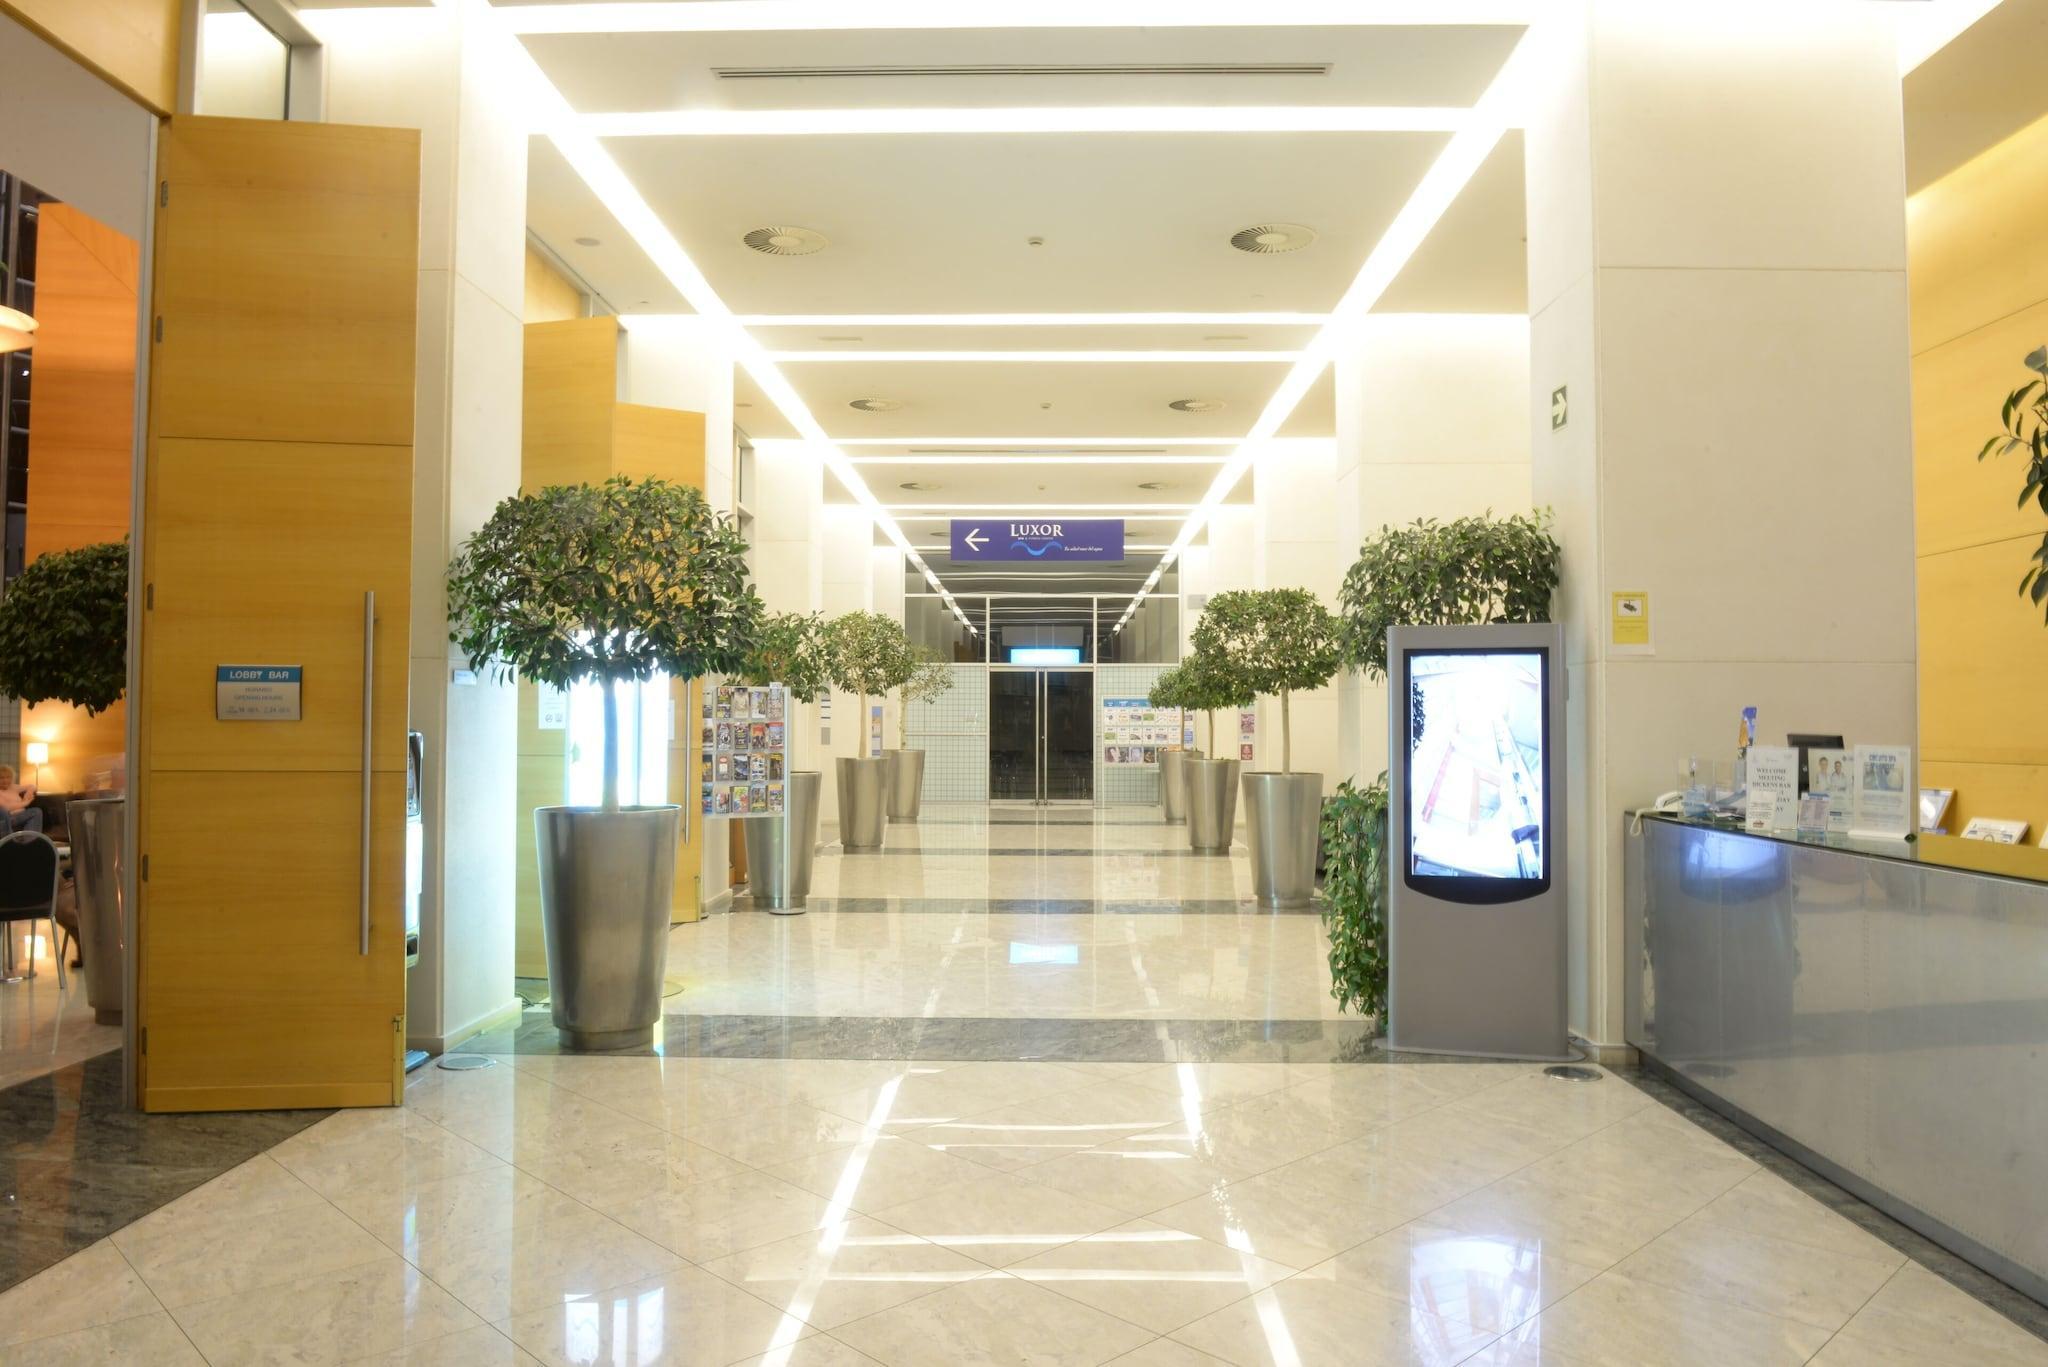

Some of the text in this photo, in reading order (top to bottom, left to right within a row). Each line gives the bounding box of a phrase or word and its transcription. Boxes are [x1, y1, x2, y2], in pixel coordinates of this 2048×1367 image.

[1010, 524, 1064, 536] LUXOR
[229, 671, 289, 679] LOBBY BAR
